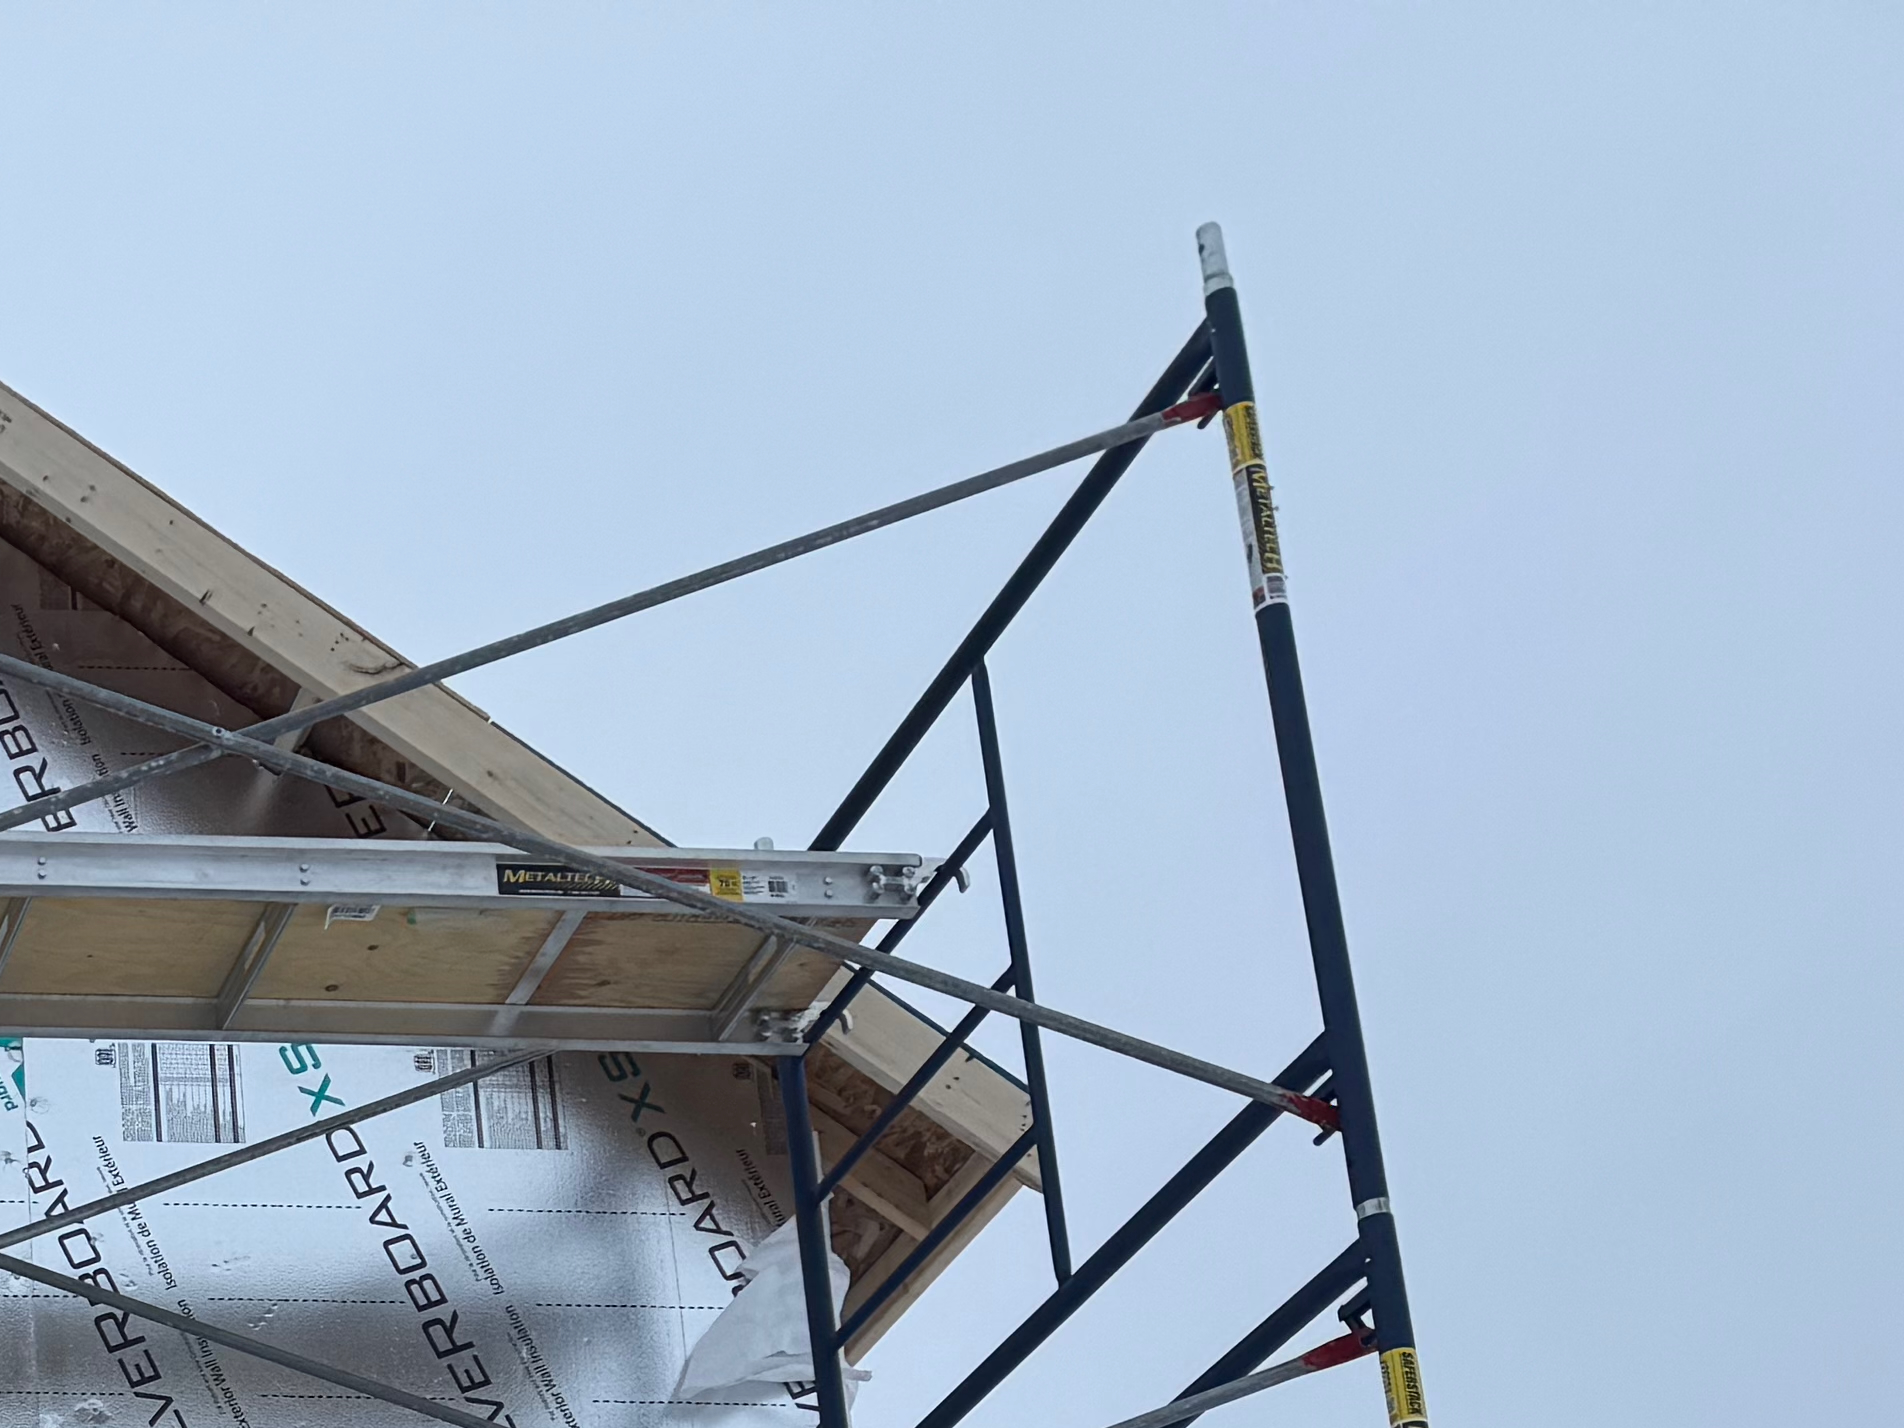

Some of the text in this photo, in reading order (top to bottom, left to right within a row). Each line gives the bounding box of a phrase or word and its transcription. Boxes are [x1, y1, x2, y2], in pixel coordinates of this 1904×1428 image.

[463, 1221, 477, 1244] de
[473, 1245, 504, 1295] Isolation
[505, 1305, 541, 1366] Insulation
